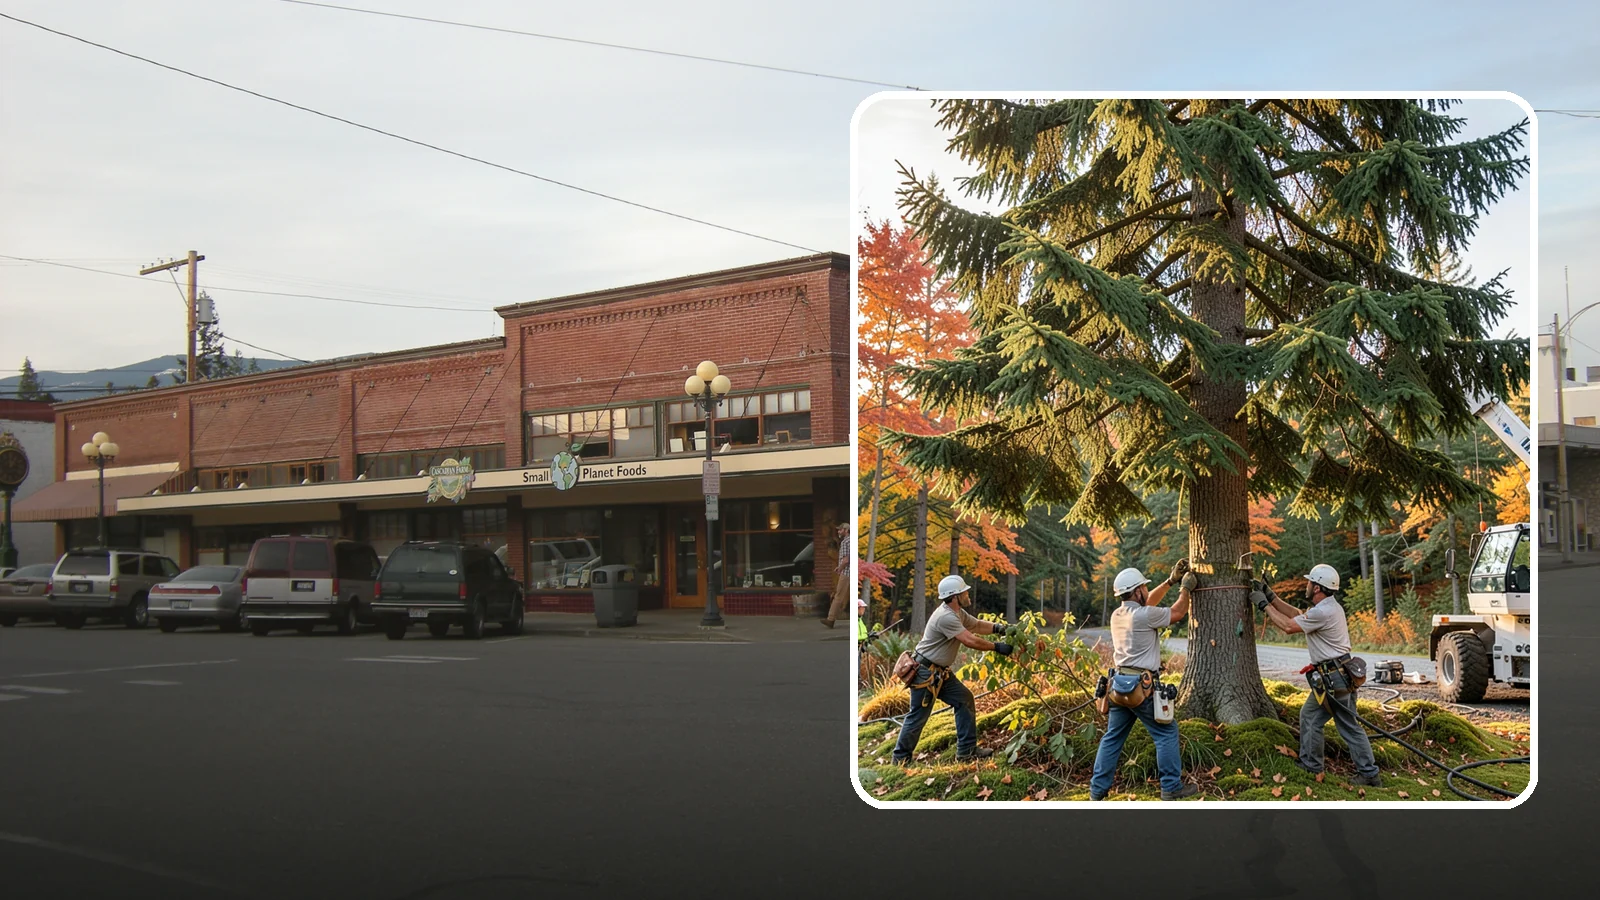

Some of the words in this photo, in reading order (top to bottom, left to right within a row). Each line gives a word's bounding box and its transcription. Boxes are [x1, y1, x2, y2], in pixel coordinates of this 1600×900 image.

[523, 472, 549, 483] Small
[582, 467, 614, 479] Planet
[616, 464, 647, 477] Foods
